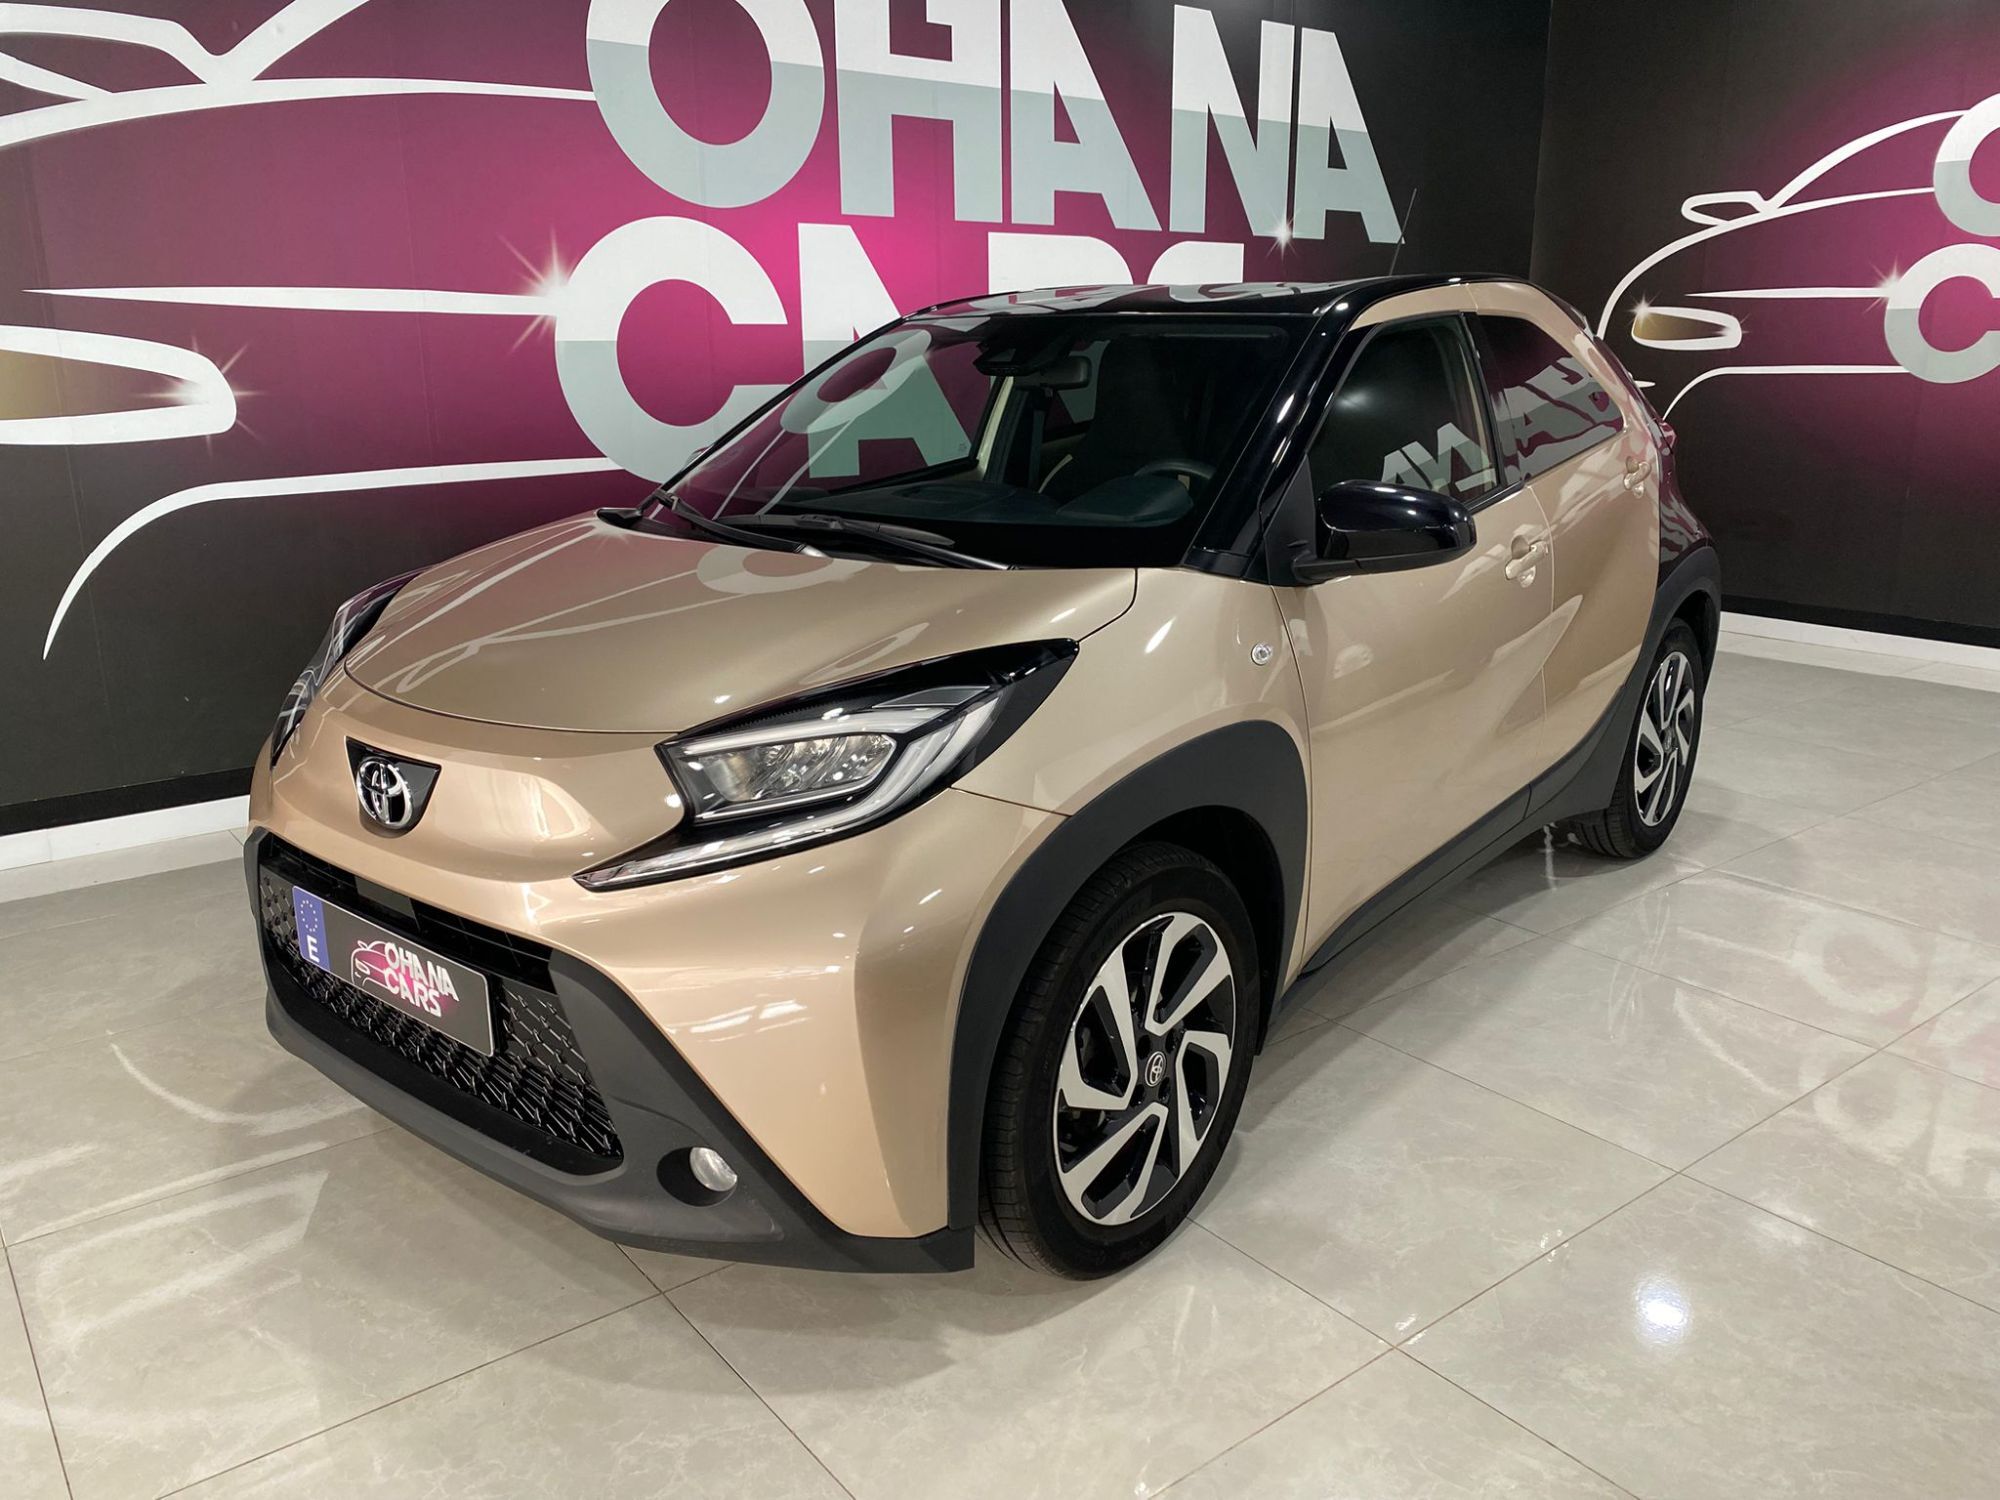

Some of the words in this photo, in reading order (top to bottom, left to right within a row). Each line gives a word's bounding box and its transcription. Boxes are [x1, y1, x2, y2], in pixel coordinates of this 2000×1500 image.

[586, 0, 1405, 244] OHANA
[307, 935, 320, 963] E
[384, 942, 460, 1001] OHANA
[384, 968, 442, 1018] CARS
